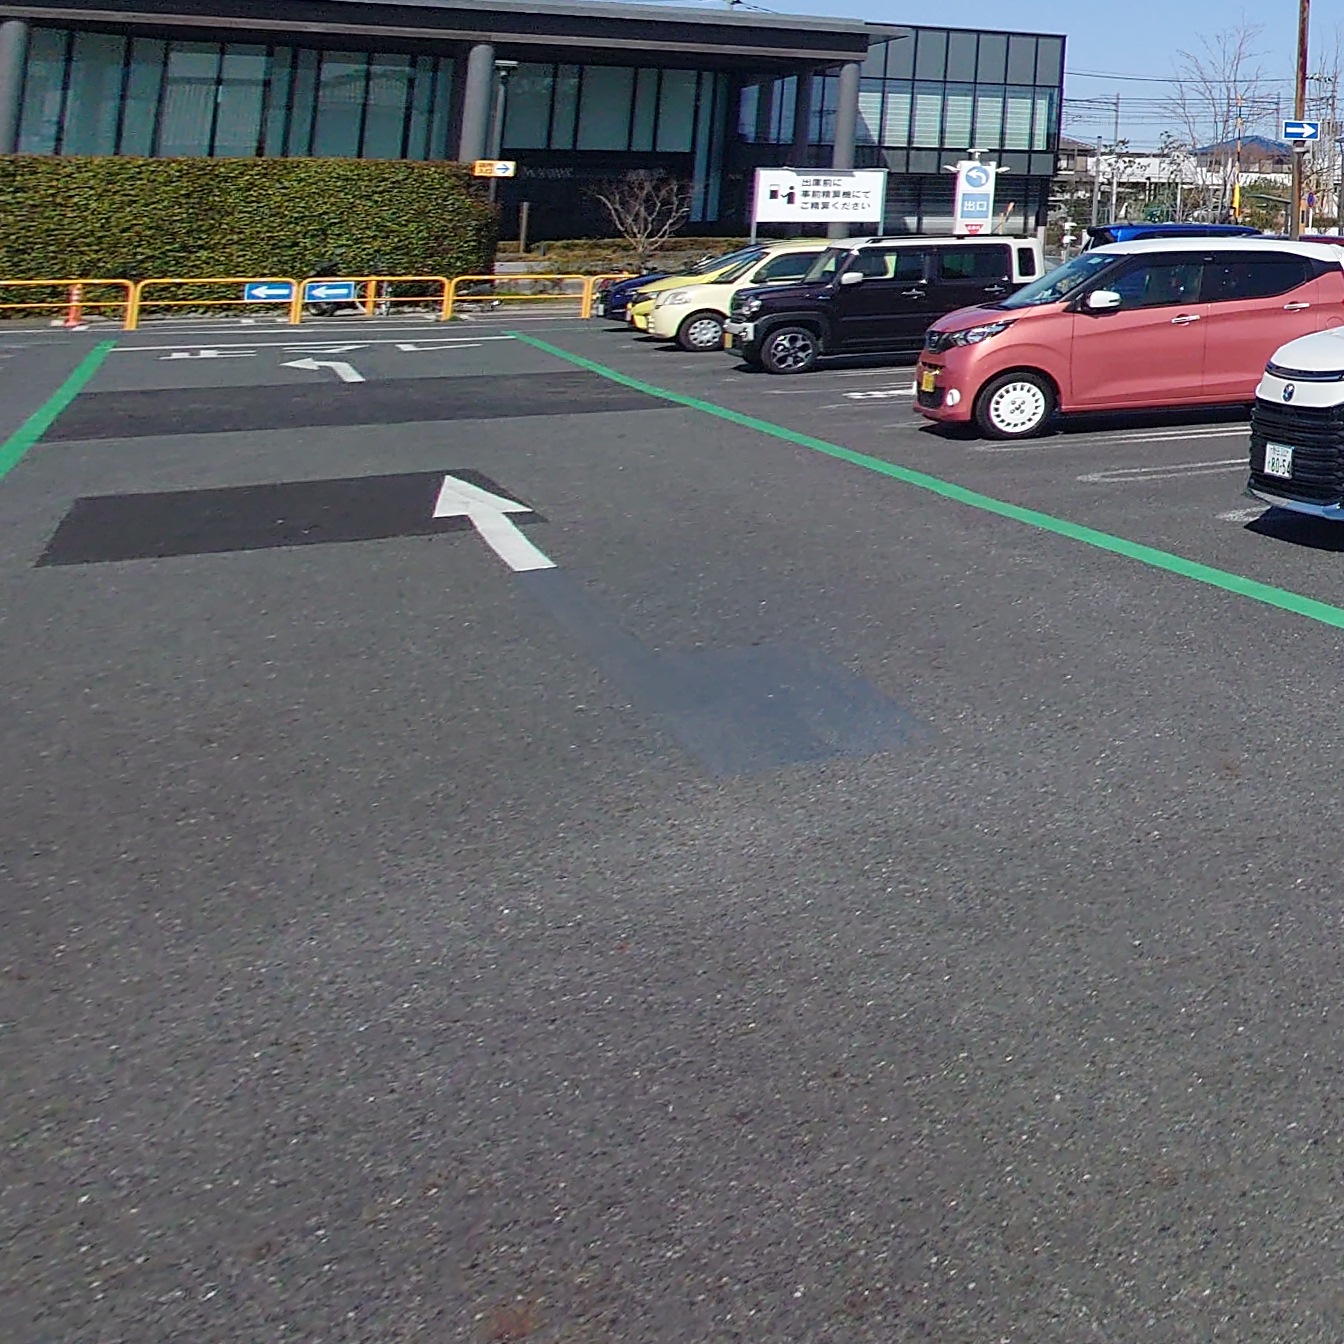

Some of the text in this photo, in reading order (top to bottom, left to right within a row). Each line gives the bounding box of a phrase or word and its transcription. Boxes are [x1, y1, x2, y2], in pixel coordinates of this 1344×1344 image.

[801, 178, 842, 187] 出庫前に
[801, 189, 871, 199] 事前精算機にて
[800, 201, 871, 211] ご精算ください
[963, 200, 988, 212] 出口
